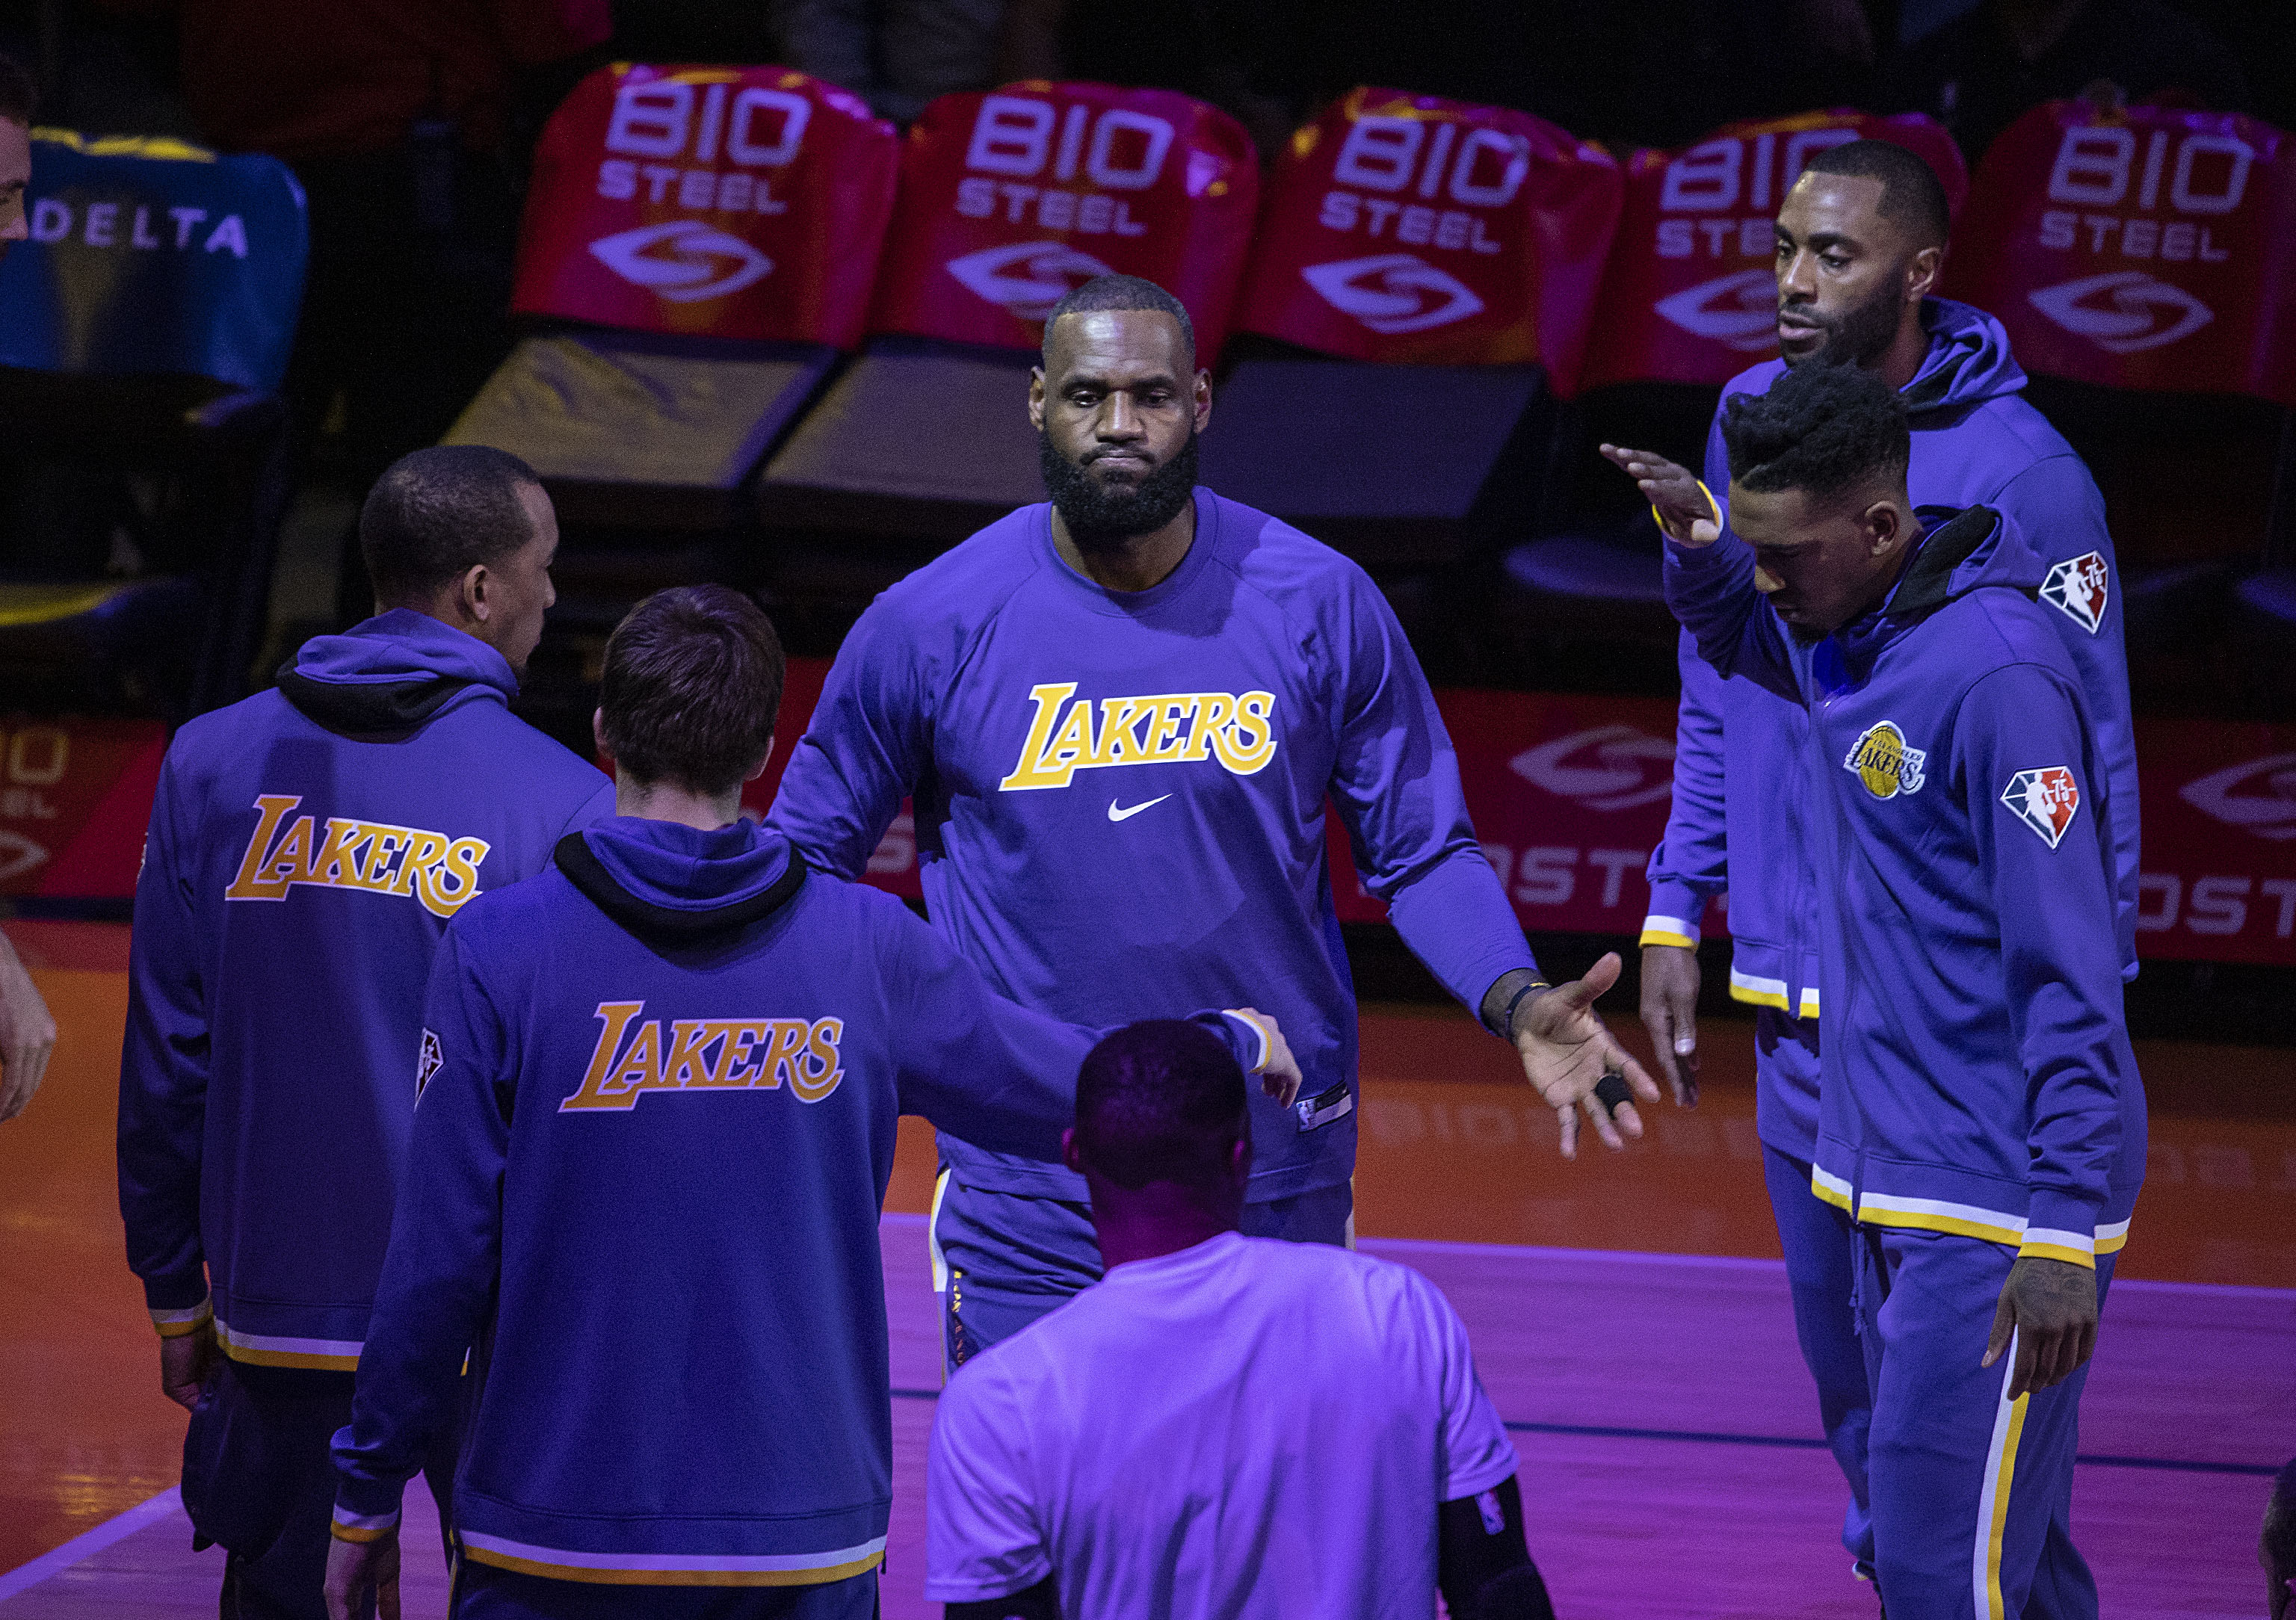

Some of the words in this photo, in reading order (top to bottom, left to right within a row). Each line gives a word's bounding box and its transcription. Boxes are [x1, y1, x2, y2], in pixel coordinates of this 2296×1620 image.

[605, 78, 812, 167] BIO
[964, 94, 1175, 191] BIO
[598, 158, 788, 217] STEEL
[1333, 114, 1530, 207] BIO
[2046, 124, 2255, 214] BIO
[30, 197, 249, 259] DELTA
[954, 177, 1149, 238] STEEL
[1318, 191, 1501, 256] STEEL
[1655, 217, 1774, 259] STE
[2040, 209, 2231, 263] STEEL
[2085, 562, 2103, 589] 75
[998, 681, 1277, 792] LAKERS
[1845, 735, 1925, 793] LAKERS
[2052, 778, 2070, 803] 75
[224, 794, 490, 918] LAKERS
[558, 1000, 846, 1113] LAKERS
